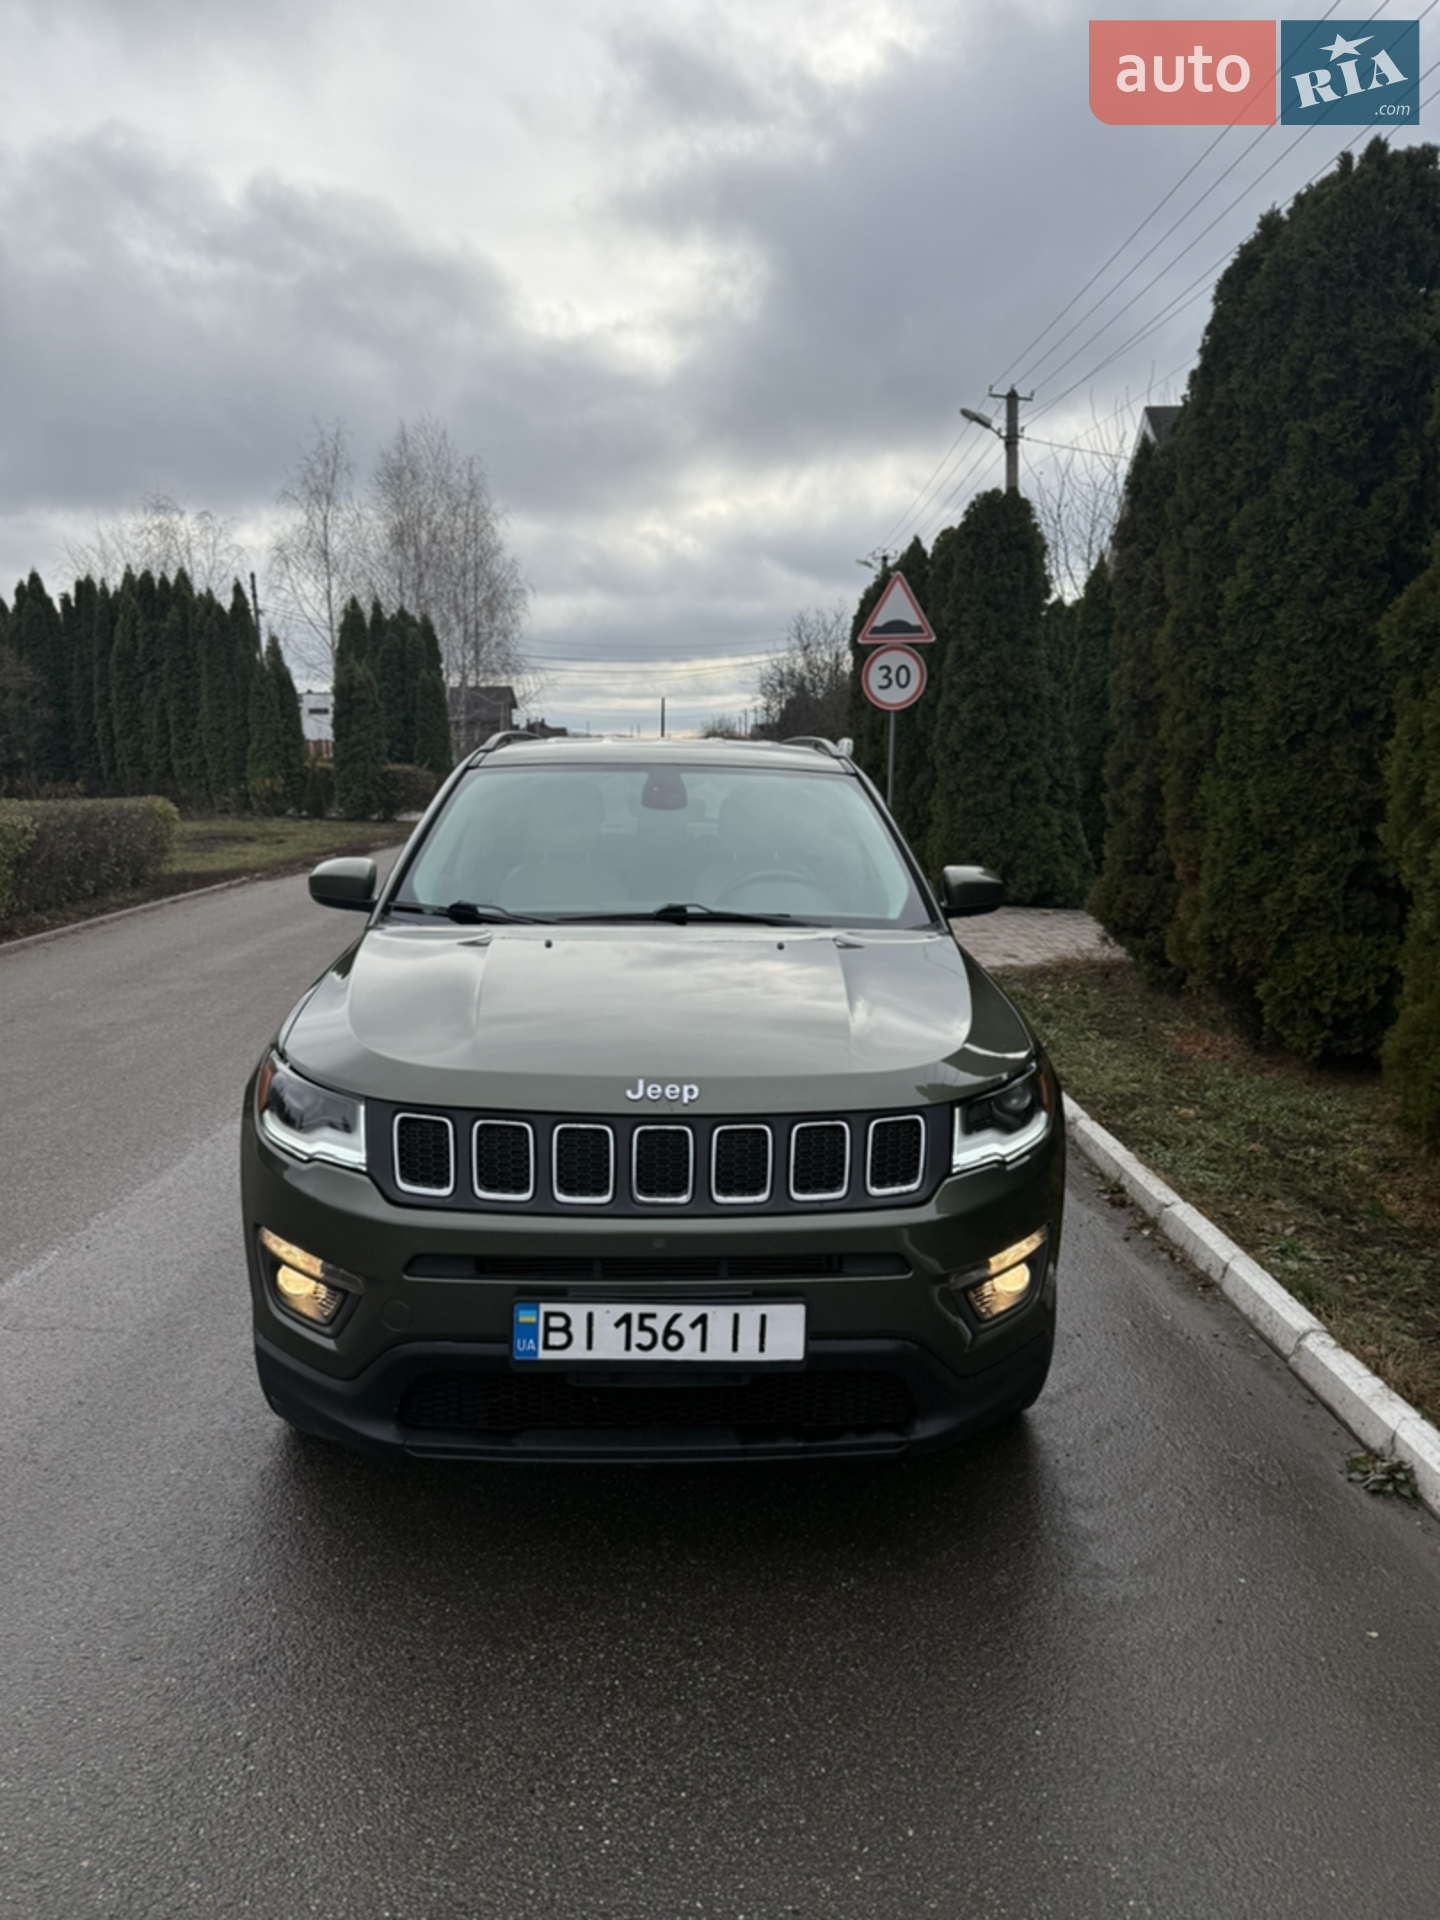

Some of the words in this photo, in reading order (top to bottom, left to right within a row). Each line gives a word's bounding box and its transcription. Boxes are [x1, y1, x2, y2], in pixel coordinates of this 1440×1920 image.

[877, 664, 911, 690] 30
[625, 1078, 700, 1105] Jeep
[516, 1339, 536, 1351] UA
[613, 1312, 708, 1353] 1561
